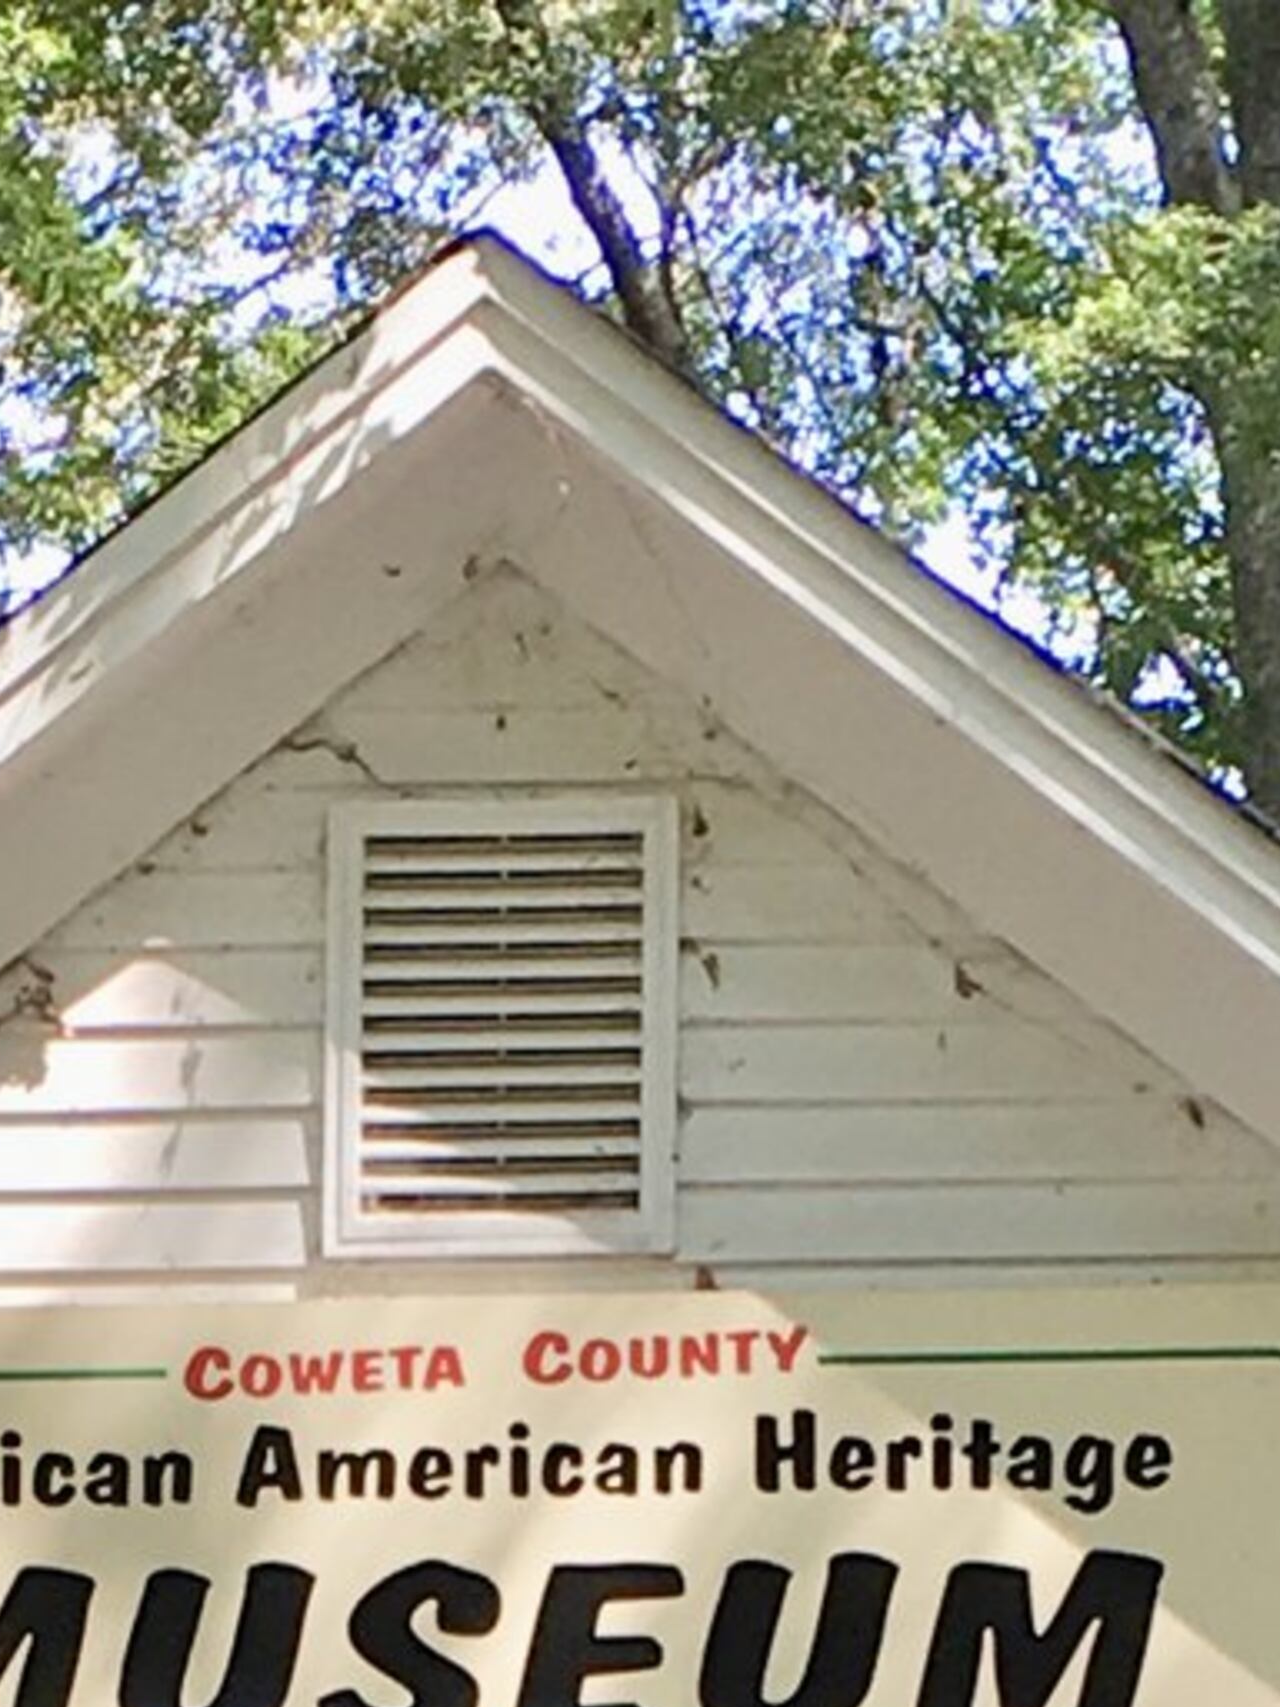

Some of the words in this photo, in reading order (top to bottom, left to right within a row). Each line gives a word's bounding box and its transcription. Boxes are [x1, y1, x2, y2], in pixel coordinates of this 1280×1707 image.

[184, 1345, 464, 1400] COWETA
[521, 1325, 808, 1385] COUNTY
[235, 1420, 702, 1509] American
[755, 1408, 1173, 1515] Heritage
